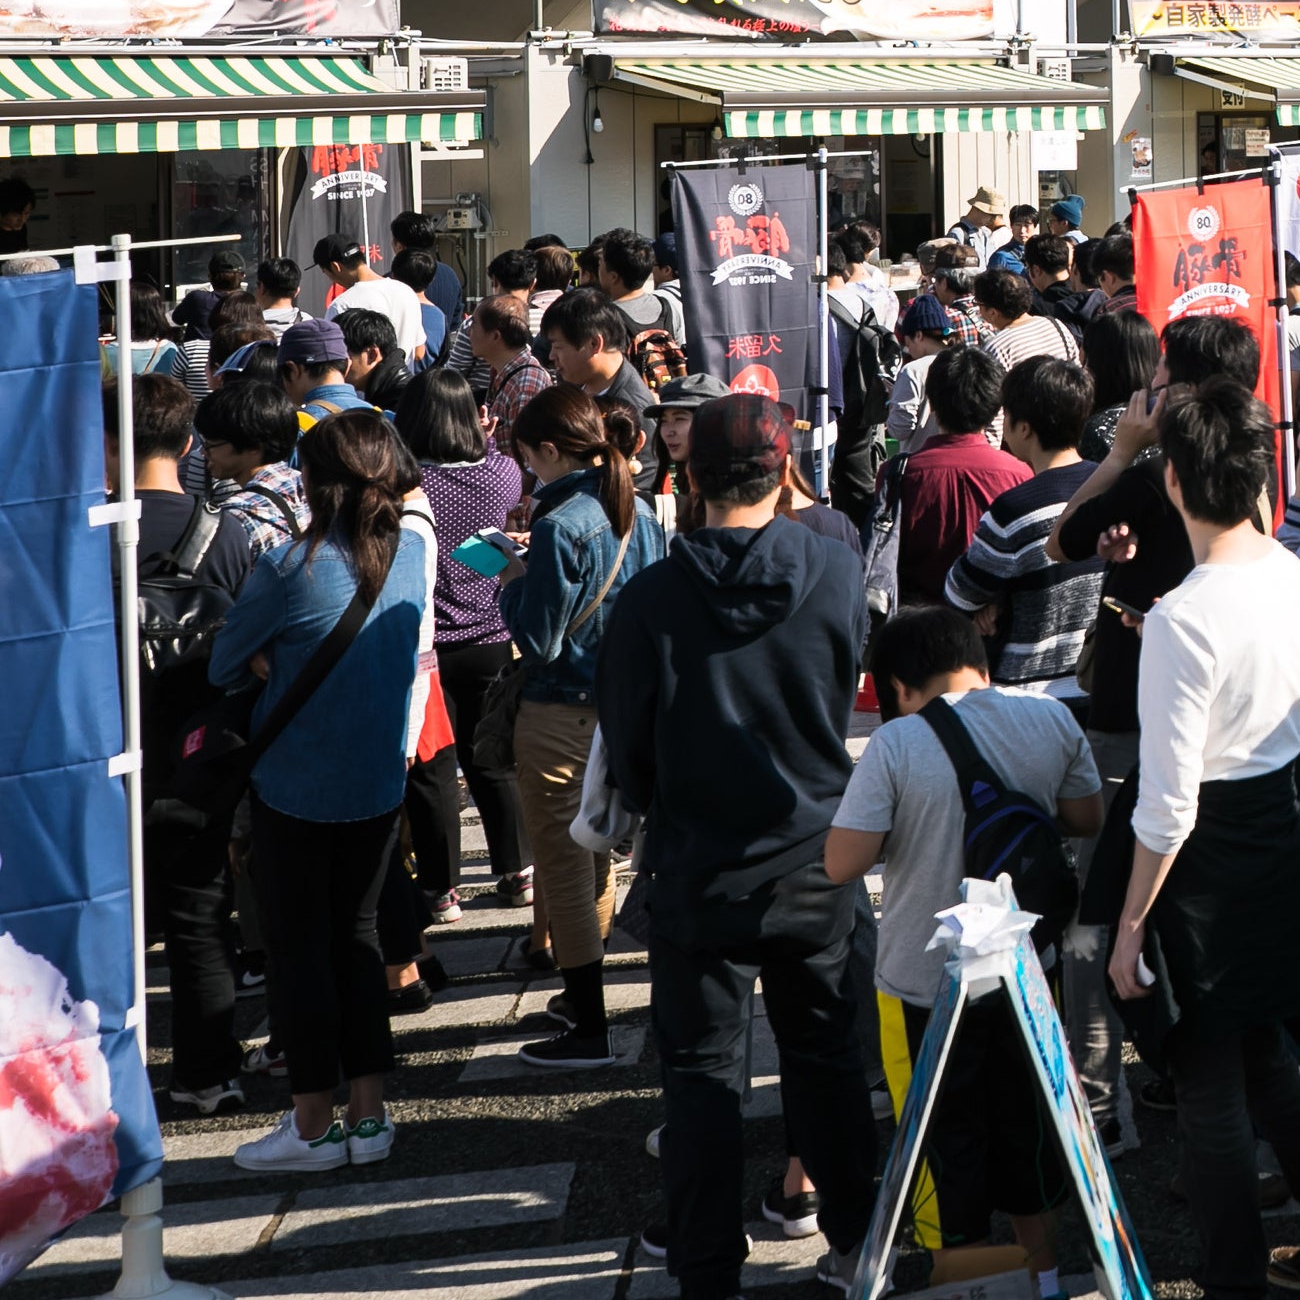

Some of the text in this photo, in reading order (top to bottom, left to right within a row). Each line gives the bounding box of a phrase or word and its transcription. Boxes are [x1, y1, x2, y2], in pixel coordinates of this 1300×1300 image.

[321, 172, 379, 189] ANNIVERARY
[327, 191, 354, 201] SINCE
[1173, 237, 1248, 293] 豚骨
[1181, 284, 1241, 305] ANNIVERSARY
